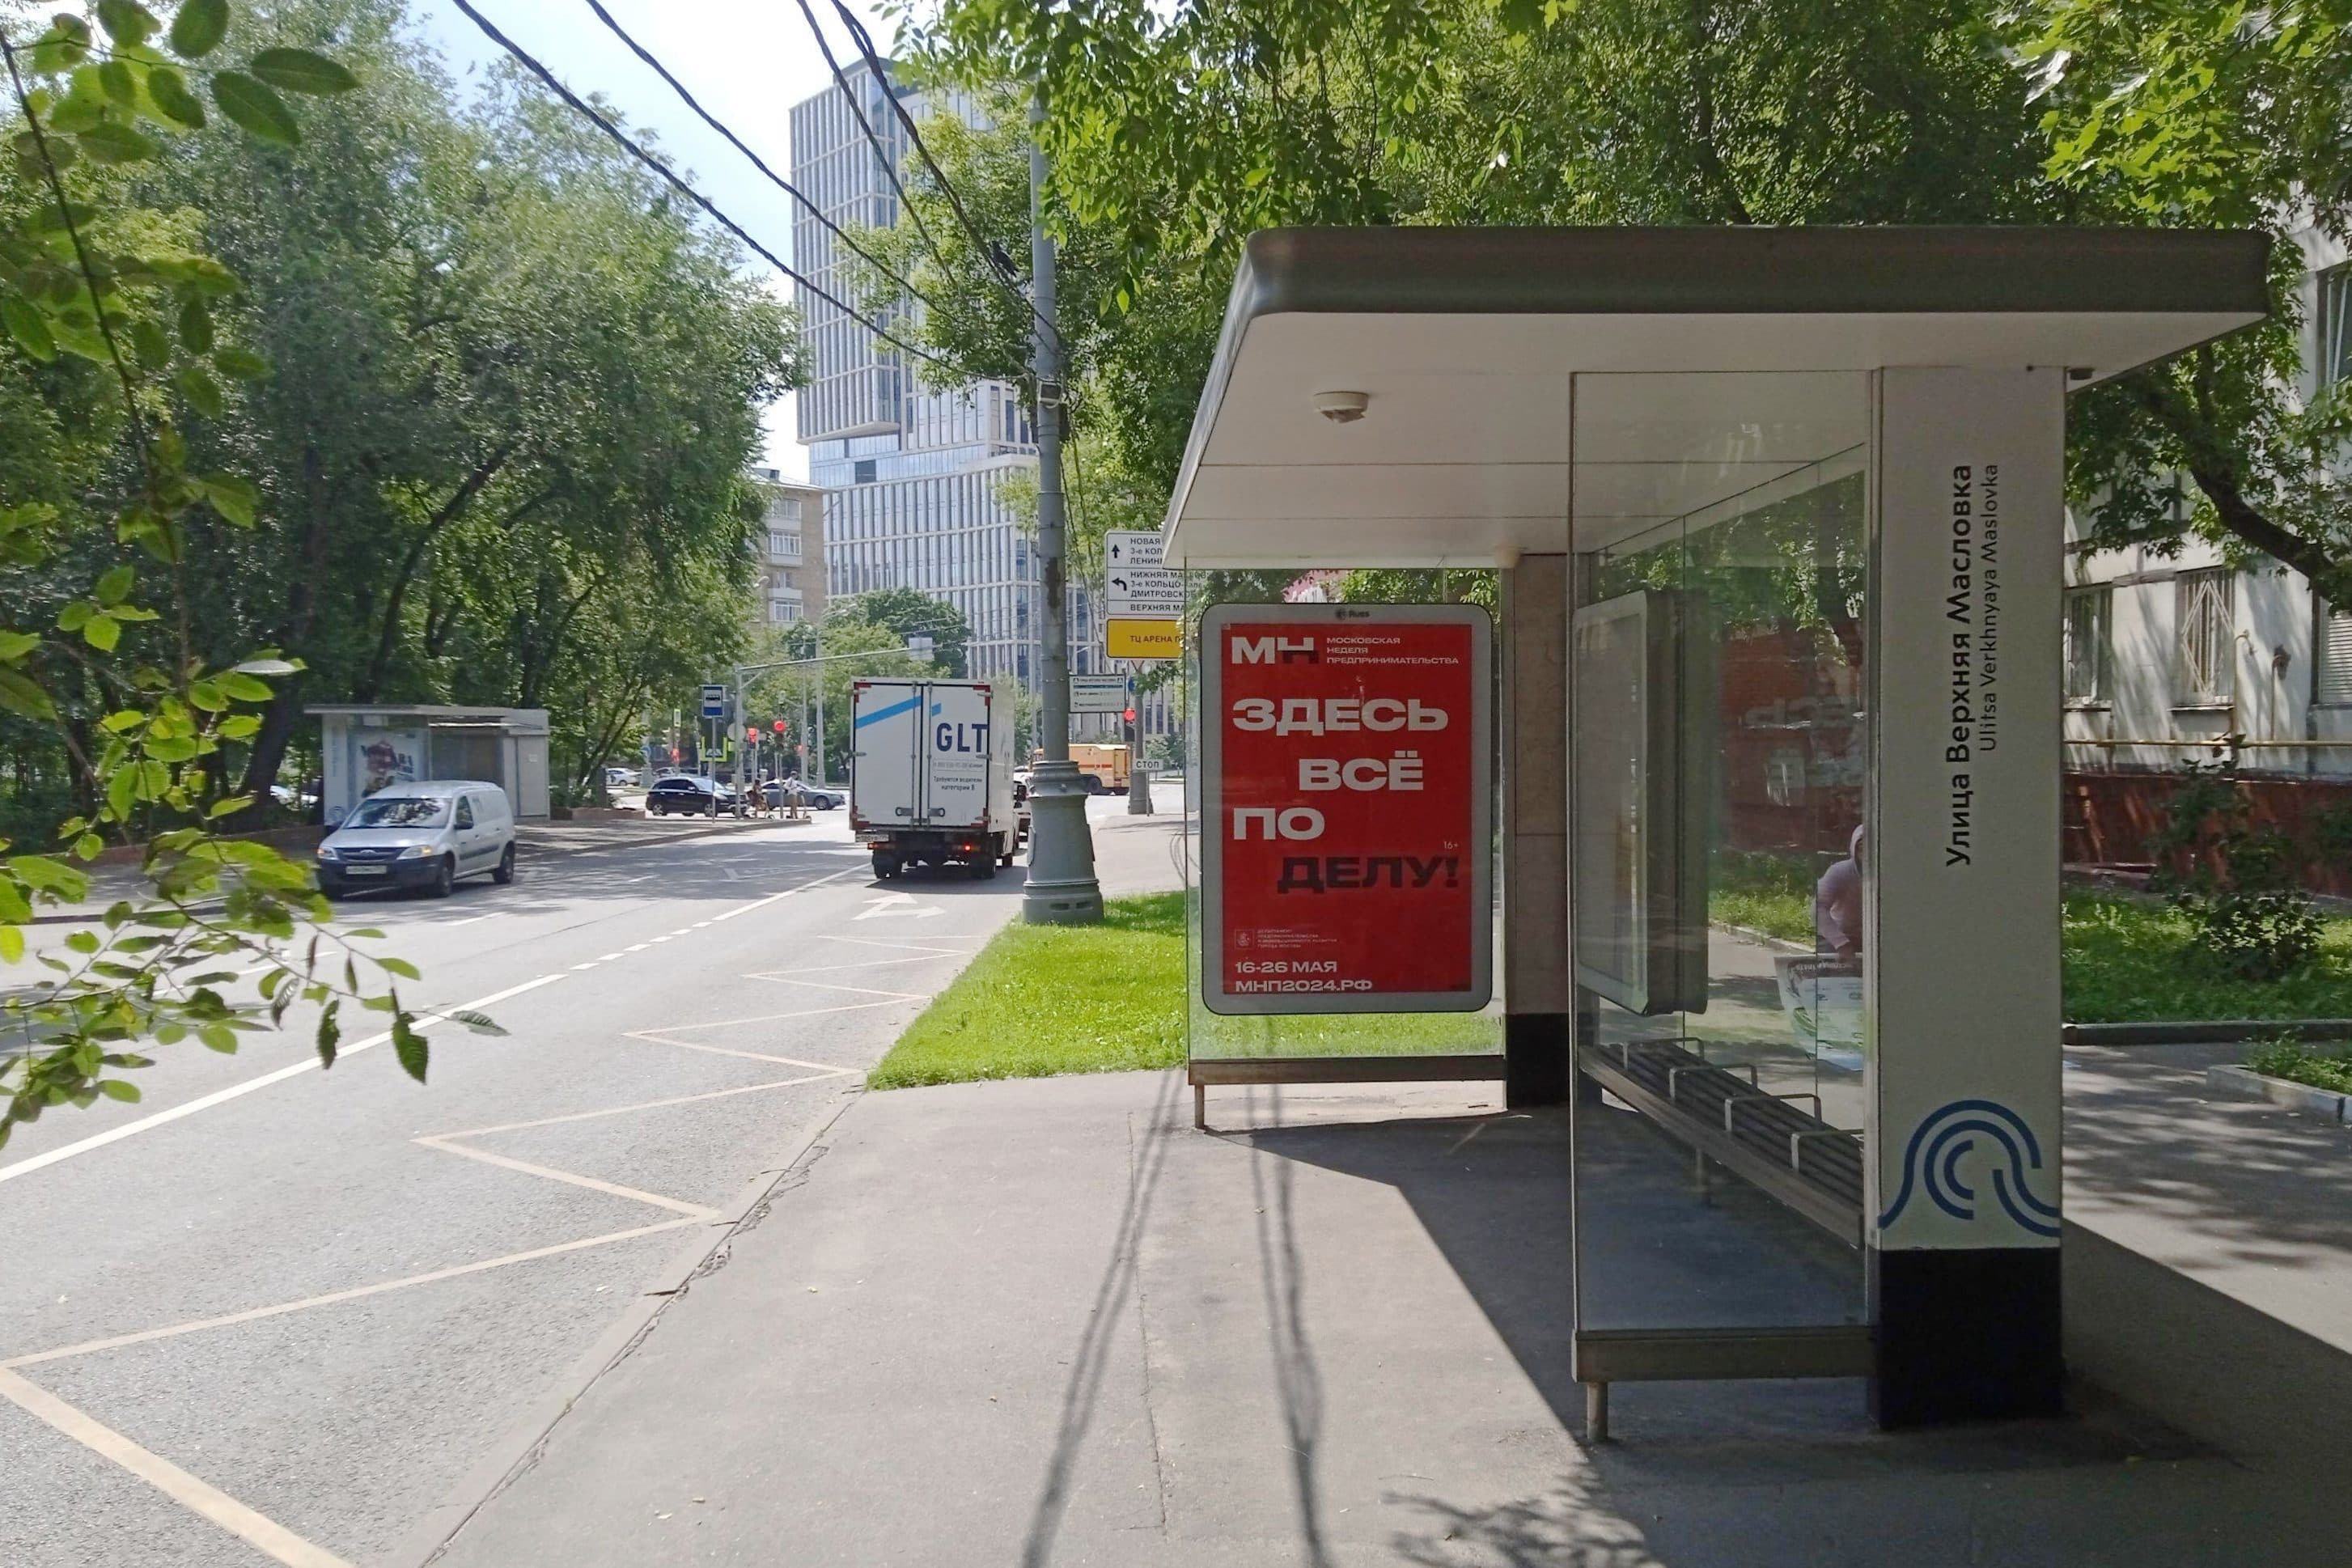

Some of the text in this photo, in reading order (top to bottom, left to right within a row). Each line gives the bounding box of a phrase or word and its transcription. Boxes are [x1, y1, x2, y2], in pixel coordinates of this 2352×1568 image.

[1129, 604, 1172, 612] ВЕРХНЯЯ
[1979, 464, 2001, 752] Ulitsa Verkhnyaya Maslovka
[1142, 635, 1173, 643] АРЕНА
[1326, 637, 1401, 645] МОСКОВСКАЯ
[1326, 656, 1460, 665] ПРЕДПРИНИМАТЕЛЬСТВА
[1945, 464, 1977, 867] Улица Верхняя Масловка
[1232, 697, 1449, 737] ЗДЕСЬ
[936, 723, 988, 753] GLT
[1136, 761, 1160, 769] СТОП
[1299, 749, 1424, 791] ВСЁ
[1233, 807, 1326, 841] ПО
[1443, 841, 1459, 850] 16+
[1277, 855, 1460, 894] ДЕЛУ!
[1235, 960, 1338, 973] 16-26 МАЯ
[1235, 979, 1373, 993] МНП2024.РФ
